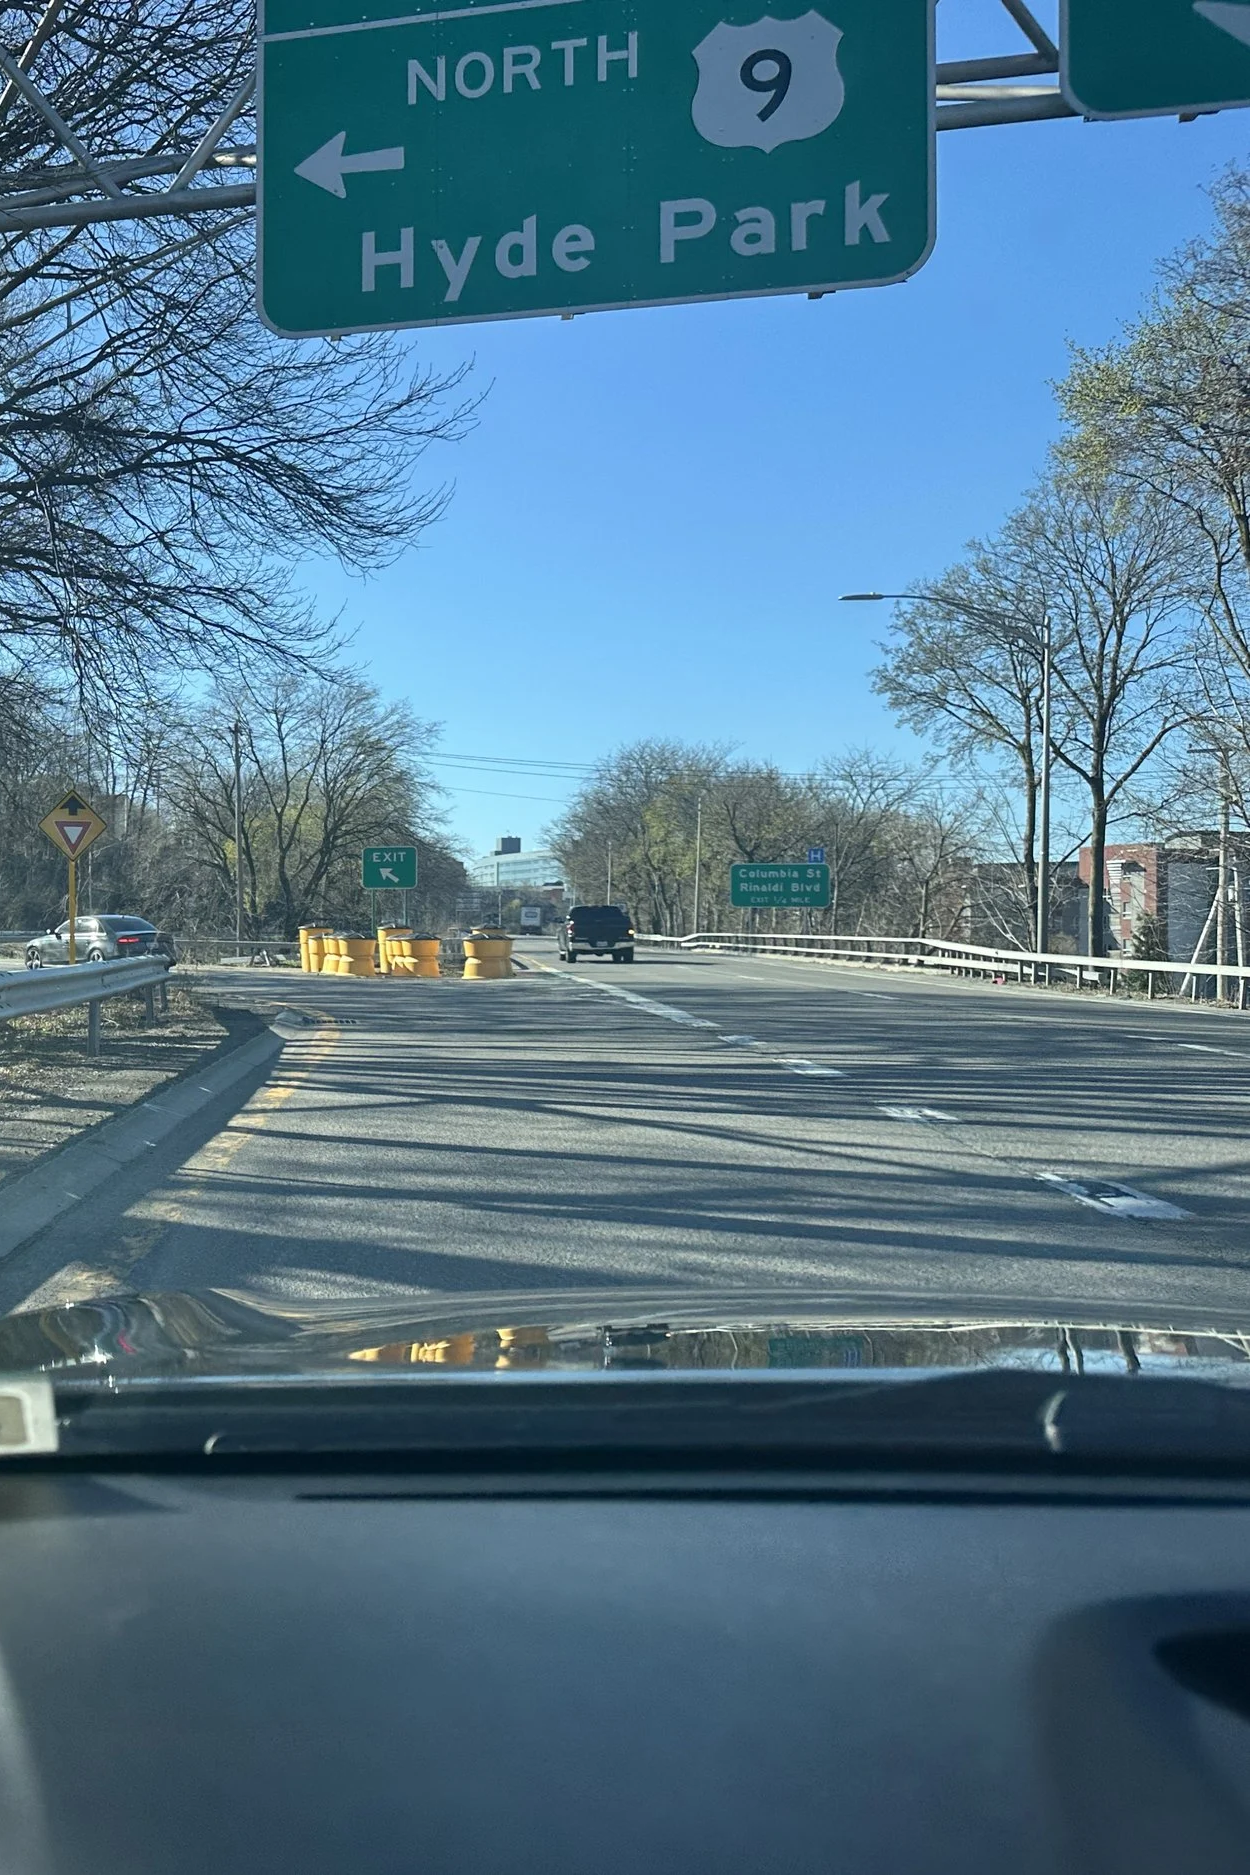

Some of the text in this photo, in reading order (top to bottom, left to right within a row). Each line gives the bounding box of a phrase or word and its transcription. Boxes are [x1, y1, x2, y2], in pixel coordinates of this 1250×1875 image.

[407, 31, 638, 106] NORTH
[739, 48, 793, 122] 9
[361, 180, 891, 302] Hyde Park
[373, 852, 406, 862] EXIT
[810, 850, 821, 861] H
[739, 869, 821, 878] Columbia St
[740, 882, 821, 892] Rinaldi Blvd
